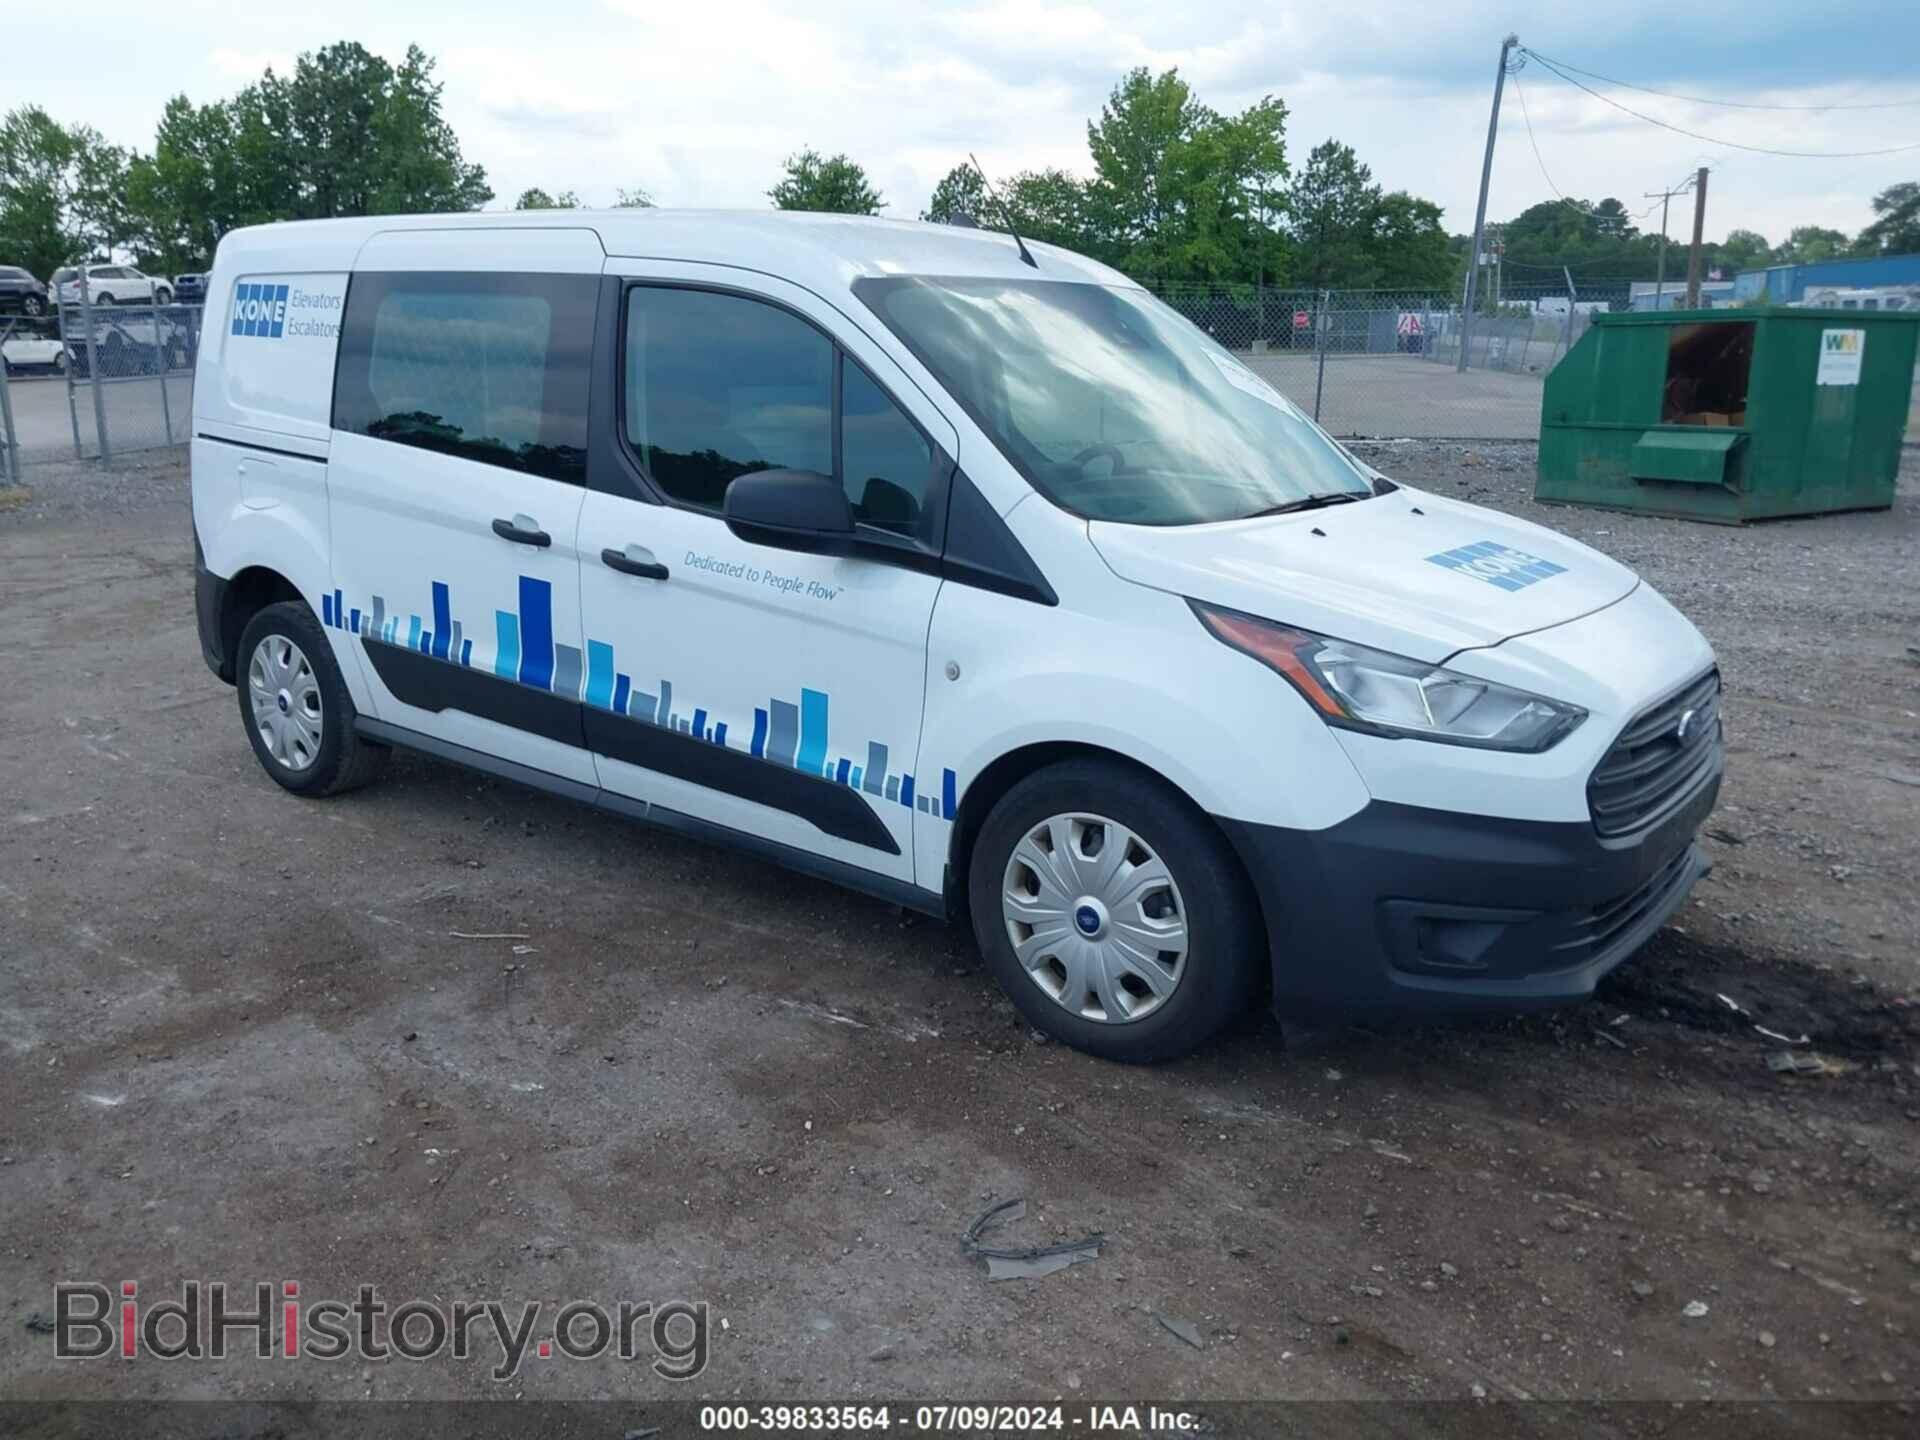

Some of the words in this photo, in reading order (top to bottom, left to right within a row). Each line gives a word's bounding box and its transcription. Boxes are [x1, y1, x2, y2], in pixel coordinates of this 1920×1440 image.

[291, 289, 342, 310] Elevators
[234, 300, 285, 322] KONE
[288, 317, 341, 338] Escalators
[1826, 334, 1857, 351] WM
[684, 551, 745, 578] Dedicated
[746, 568, 760, 582] to
[762, 570, 803, 594] People
